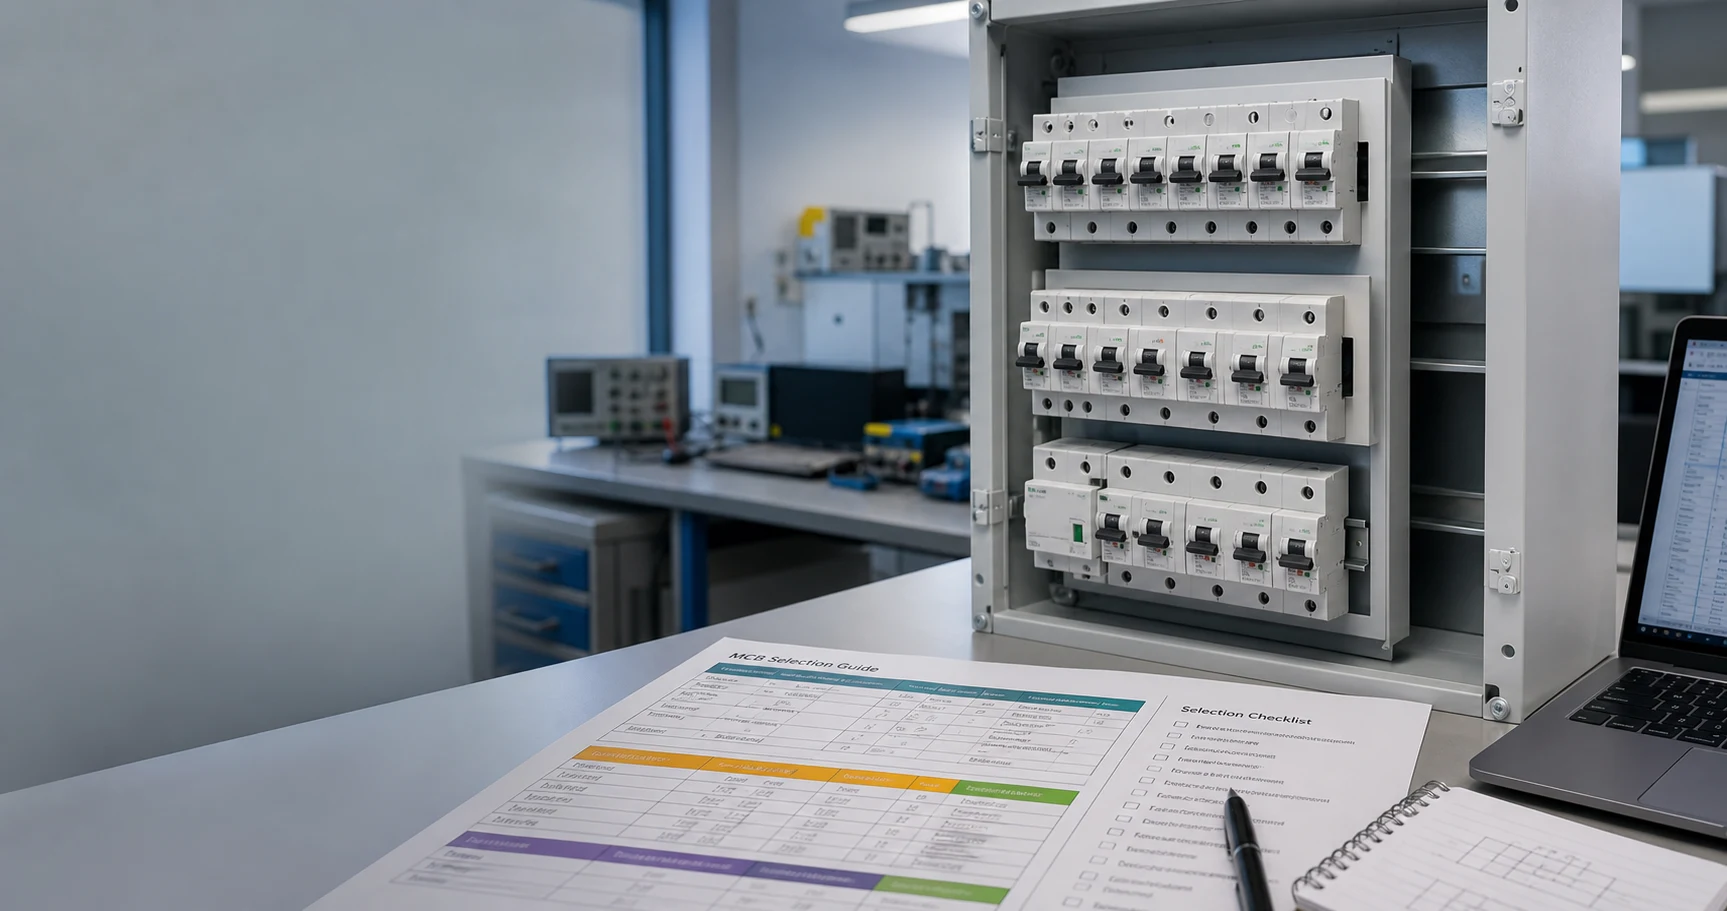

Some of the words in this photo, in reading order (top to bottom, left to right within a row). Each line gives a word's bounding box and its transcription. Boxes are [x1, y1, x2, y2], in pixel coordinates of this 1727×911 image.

[728, 652, 766, 662] MCB
[767, 656, 834, 668] Selection
[837, 662, 880, 673] Guide
[1181, 705, 1244, 718] Selection
[1248, 712, 1312, 725] Checklist
